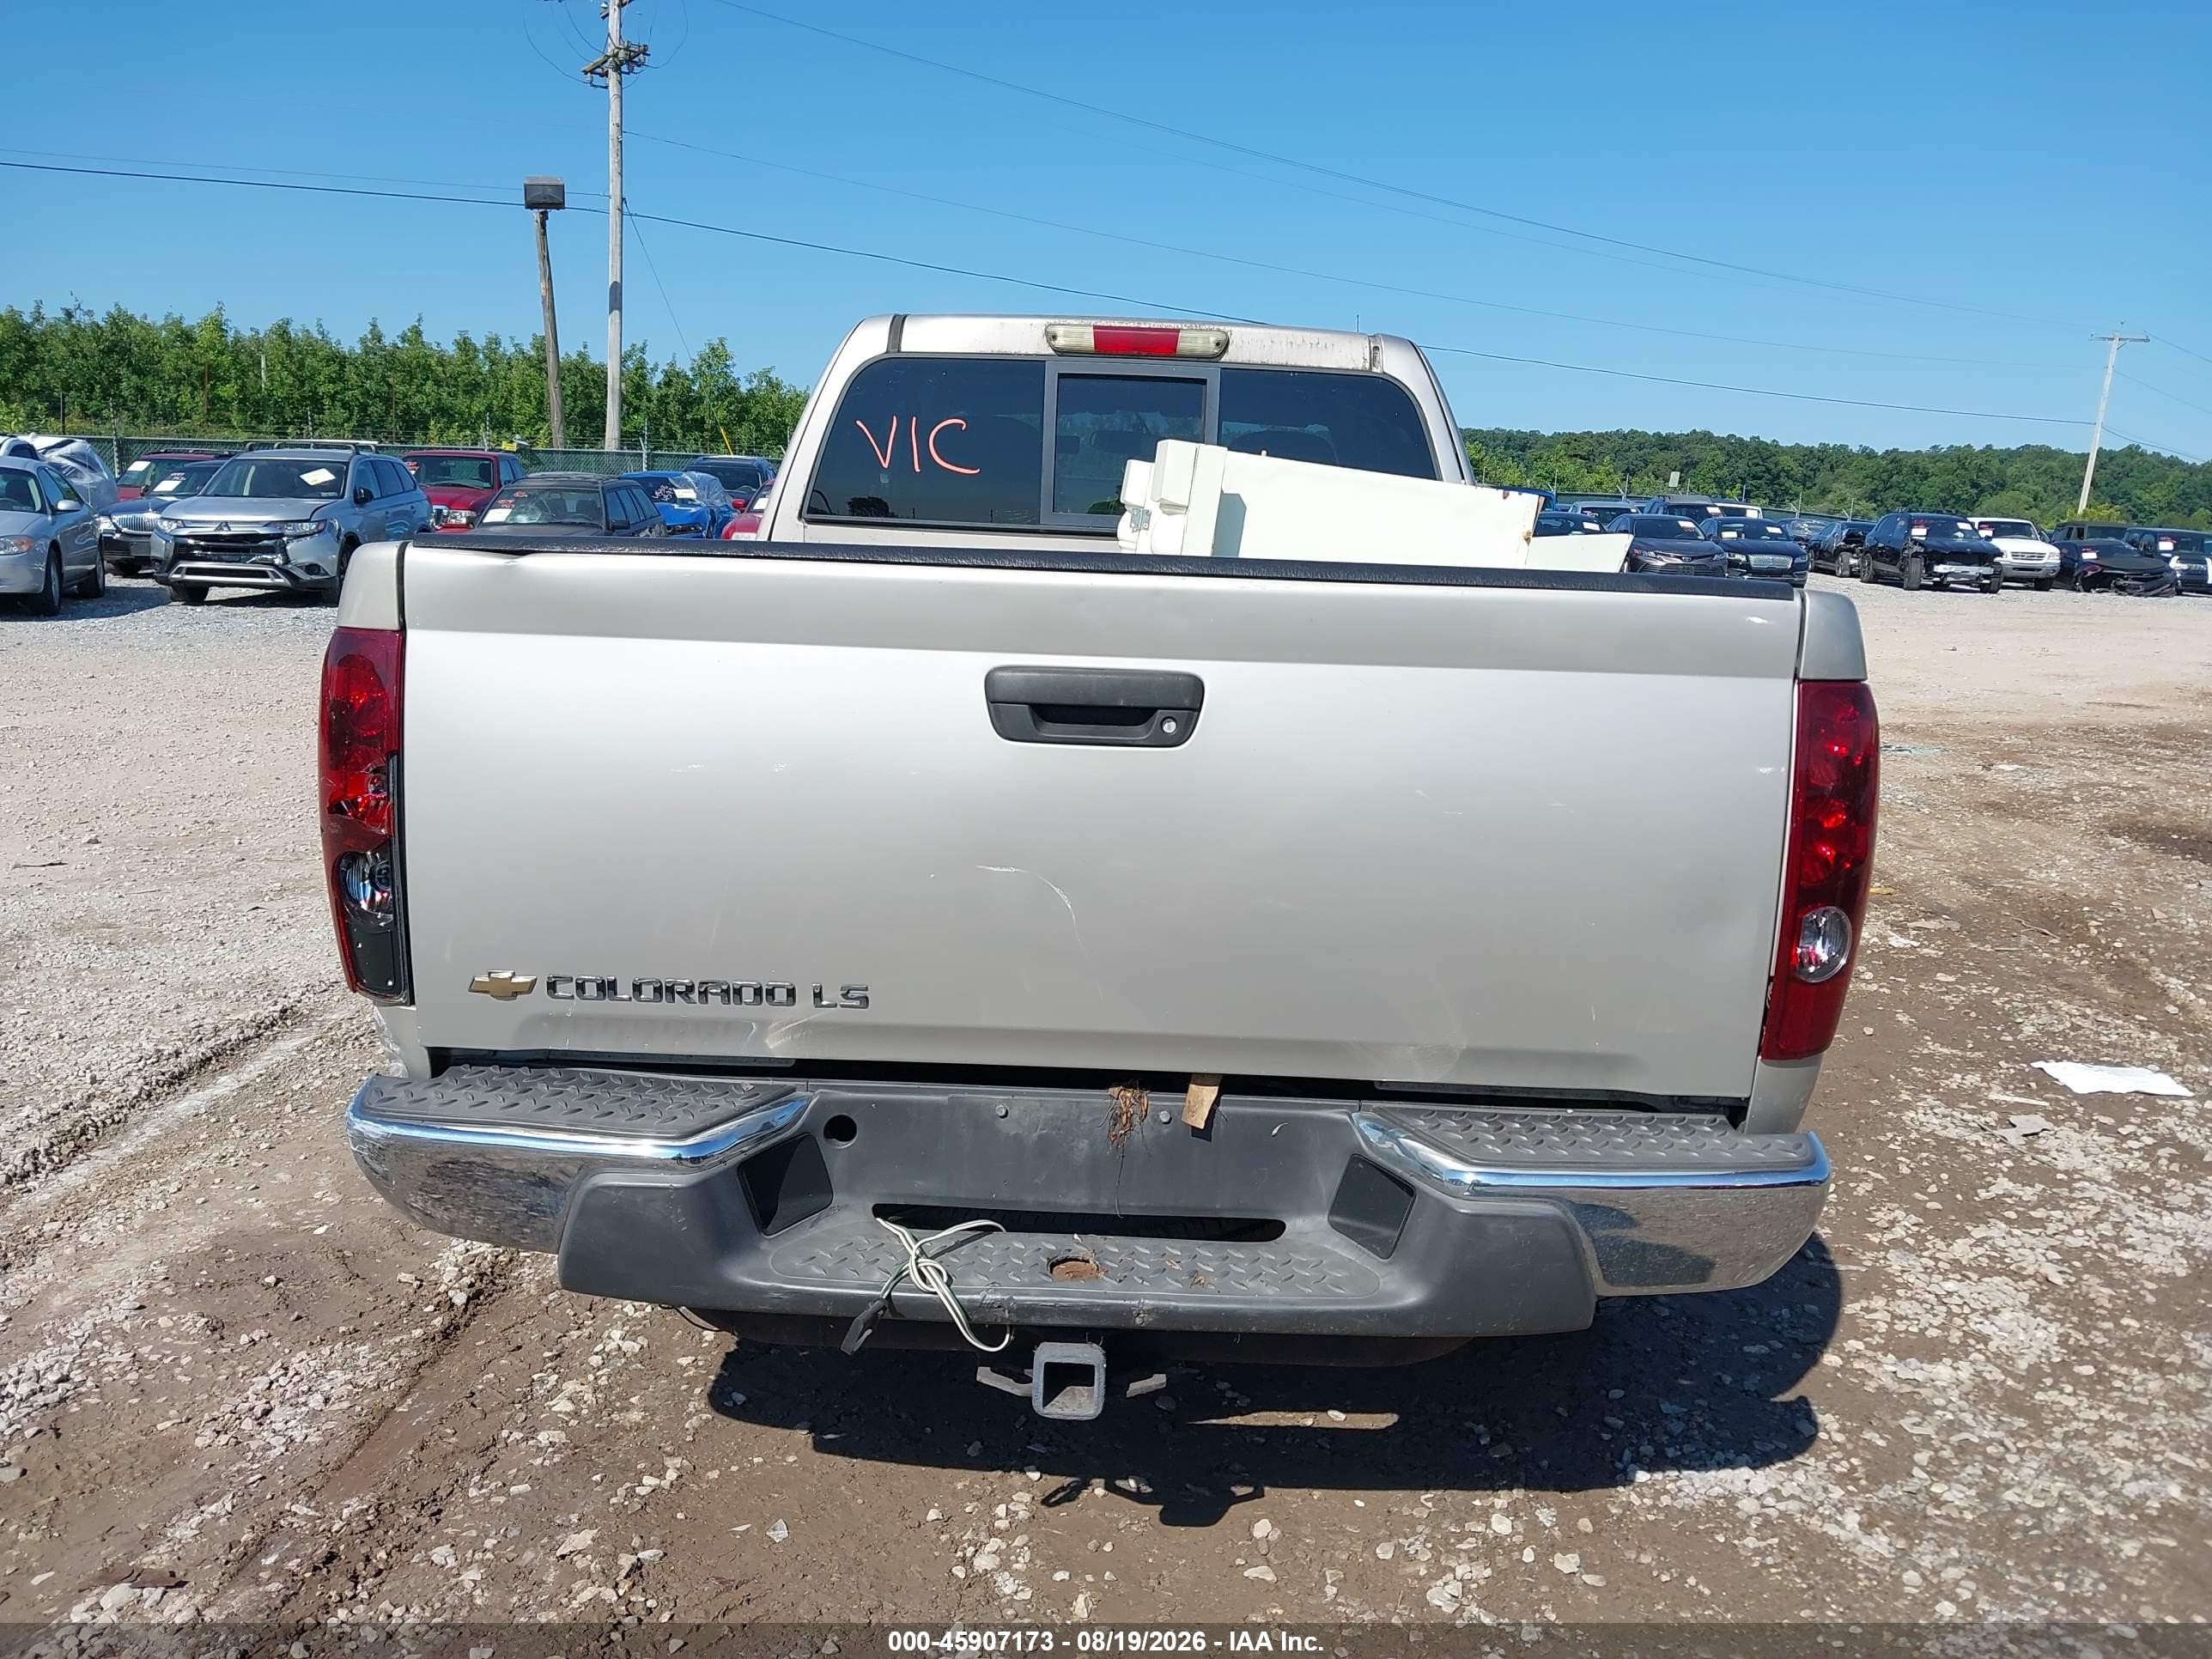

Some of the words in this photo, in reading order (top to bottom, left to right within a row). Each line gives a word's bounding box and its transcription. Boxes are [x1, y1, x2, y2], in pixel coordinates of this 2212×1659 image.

[856, 415, 981, 473] VIC
[546, 975, 796, 1006] COLORADO
[811, 982, 869, 1009] LS
